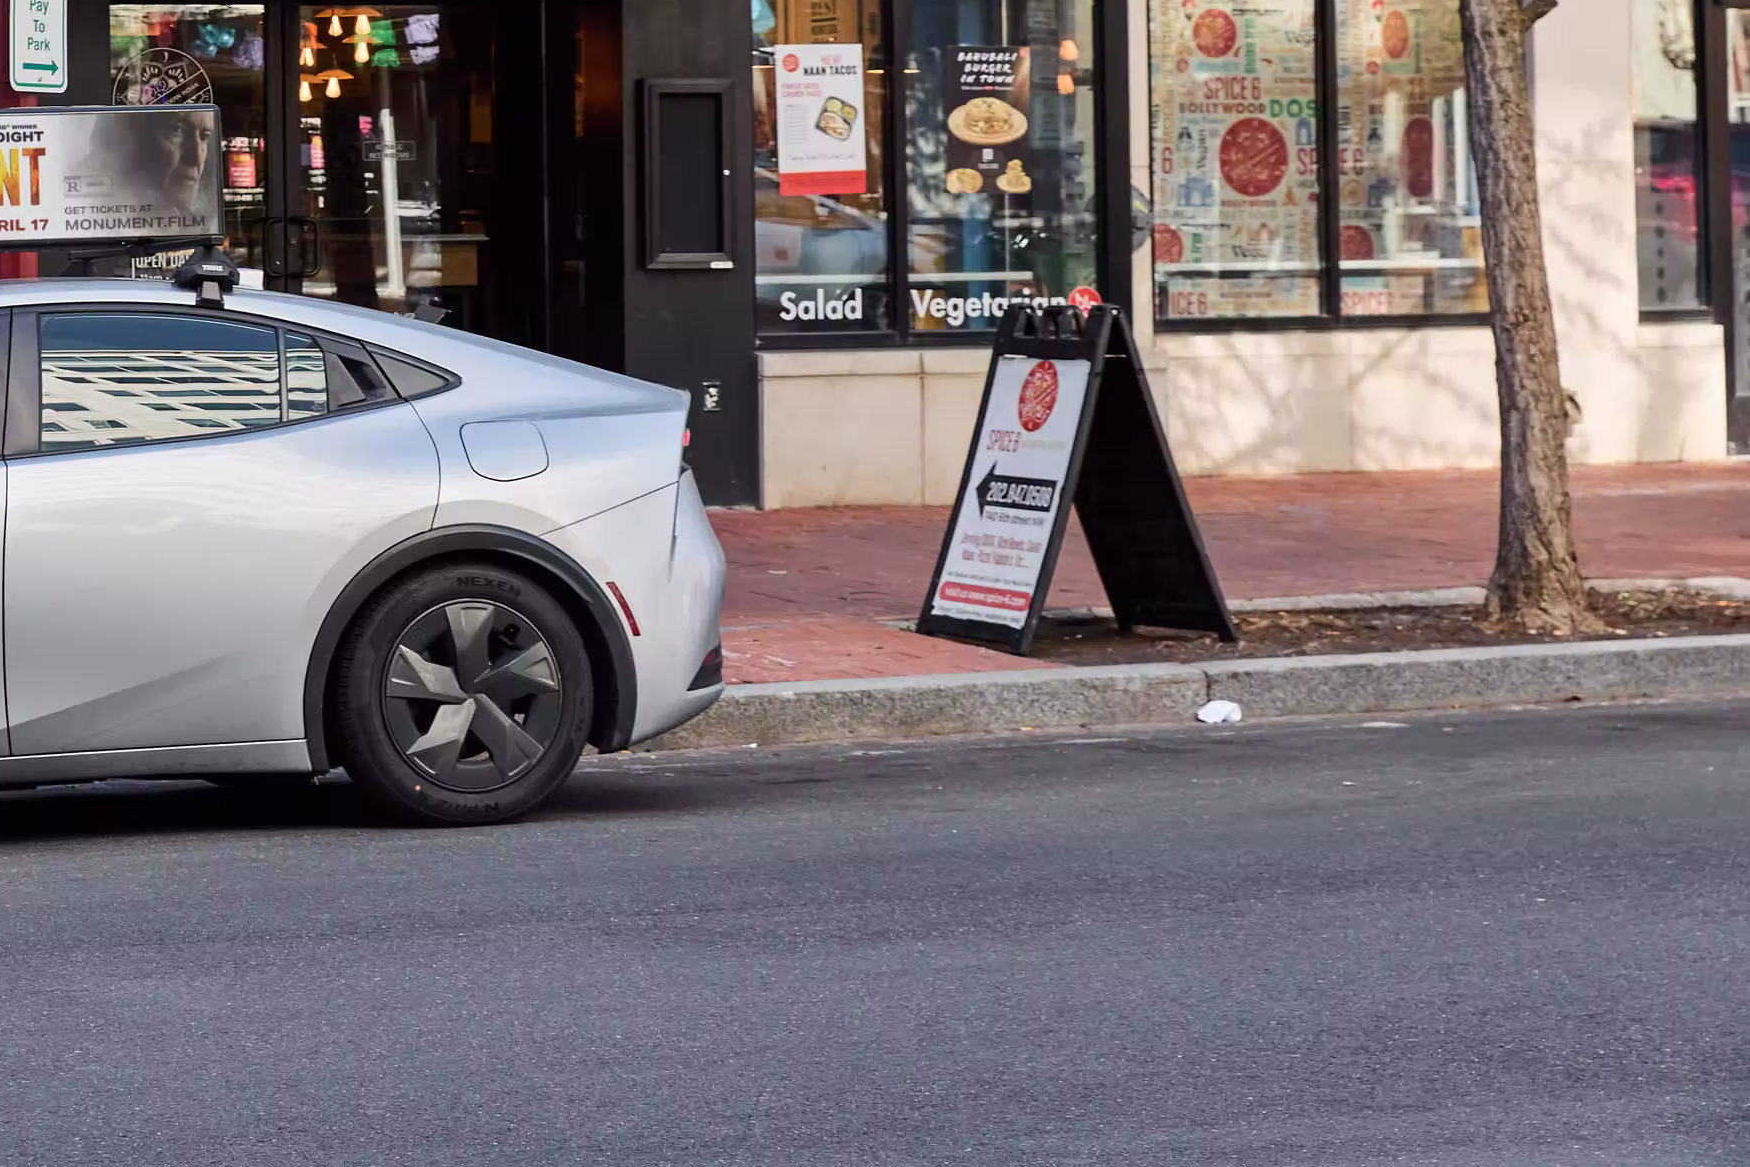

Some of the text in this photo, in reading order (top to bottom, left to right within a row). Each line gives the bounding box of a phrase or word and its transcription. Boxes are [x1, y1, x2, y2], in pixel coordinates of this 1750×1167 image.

[33, 19, 46, 33] To
[27, 36, 51, 51] Park
[964, 63, 1013, 74] BURGER
[980, 74, 1015, 84] TOWN
[1203, 76, 1262, 101] SPICE 6
[11, 123, 38, 131] WINNER
[65, 180, 80, 193] R
[64, 205, 87, 215] GET
[88, 204, 137, 214] TICKETS
[30, 218, 49, 231] 17
[65, 215, 206, 231] MONUMENT.FILM
[779, 288, 863, 321] Salad
[456, 576, 521, 597] NEXEN
